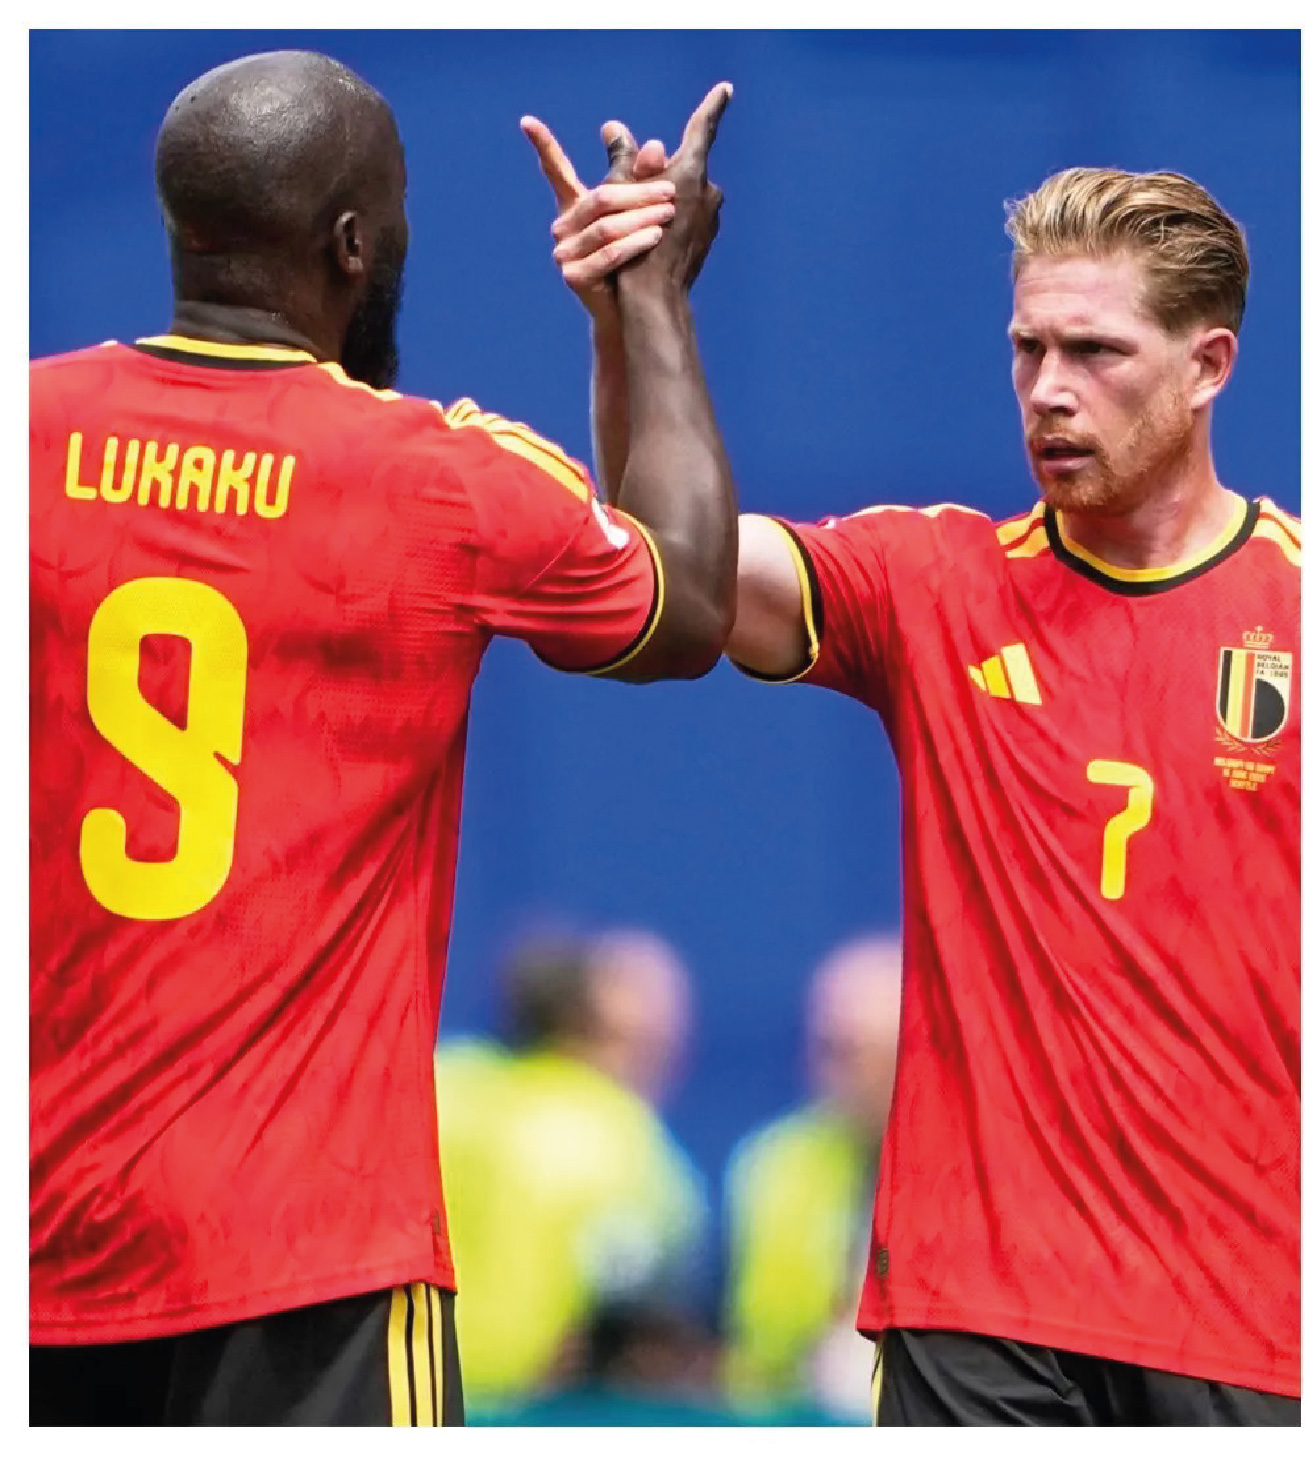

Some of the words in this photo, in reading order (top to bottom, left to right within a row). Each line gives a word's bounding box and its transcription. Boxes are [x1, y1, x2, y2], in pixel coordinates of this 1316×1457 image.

[65, 431, 296, 519] LUKAKU
[79, 576, 248, 920] 9
[1086, 758, 1154, 900] 7
